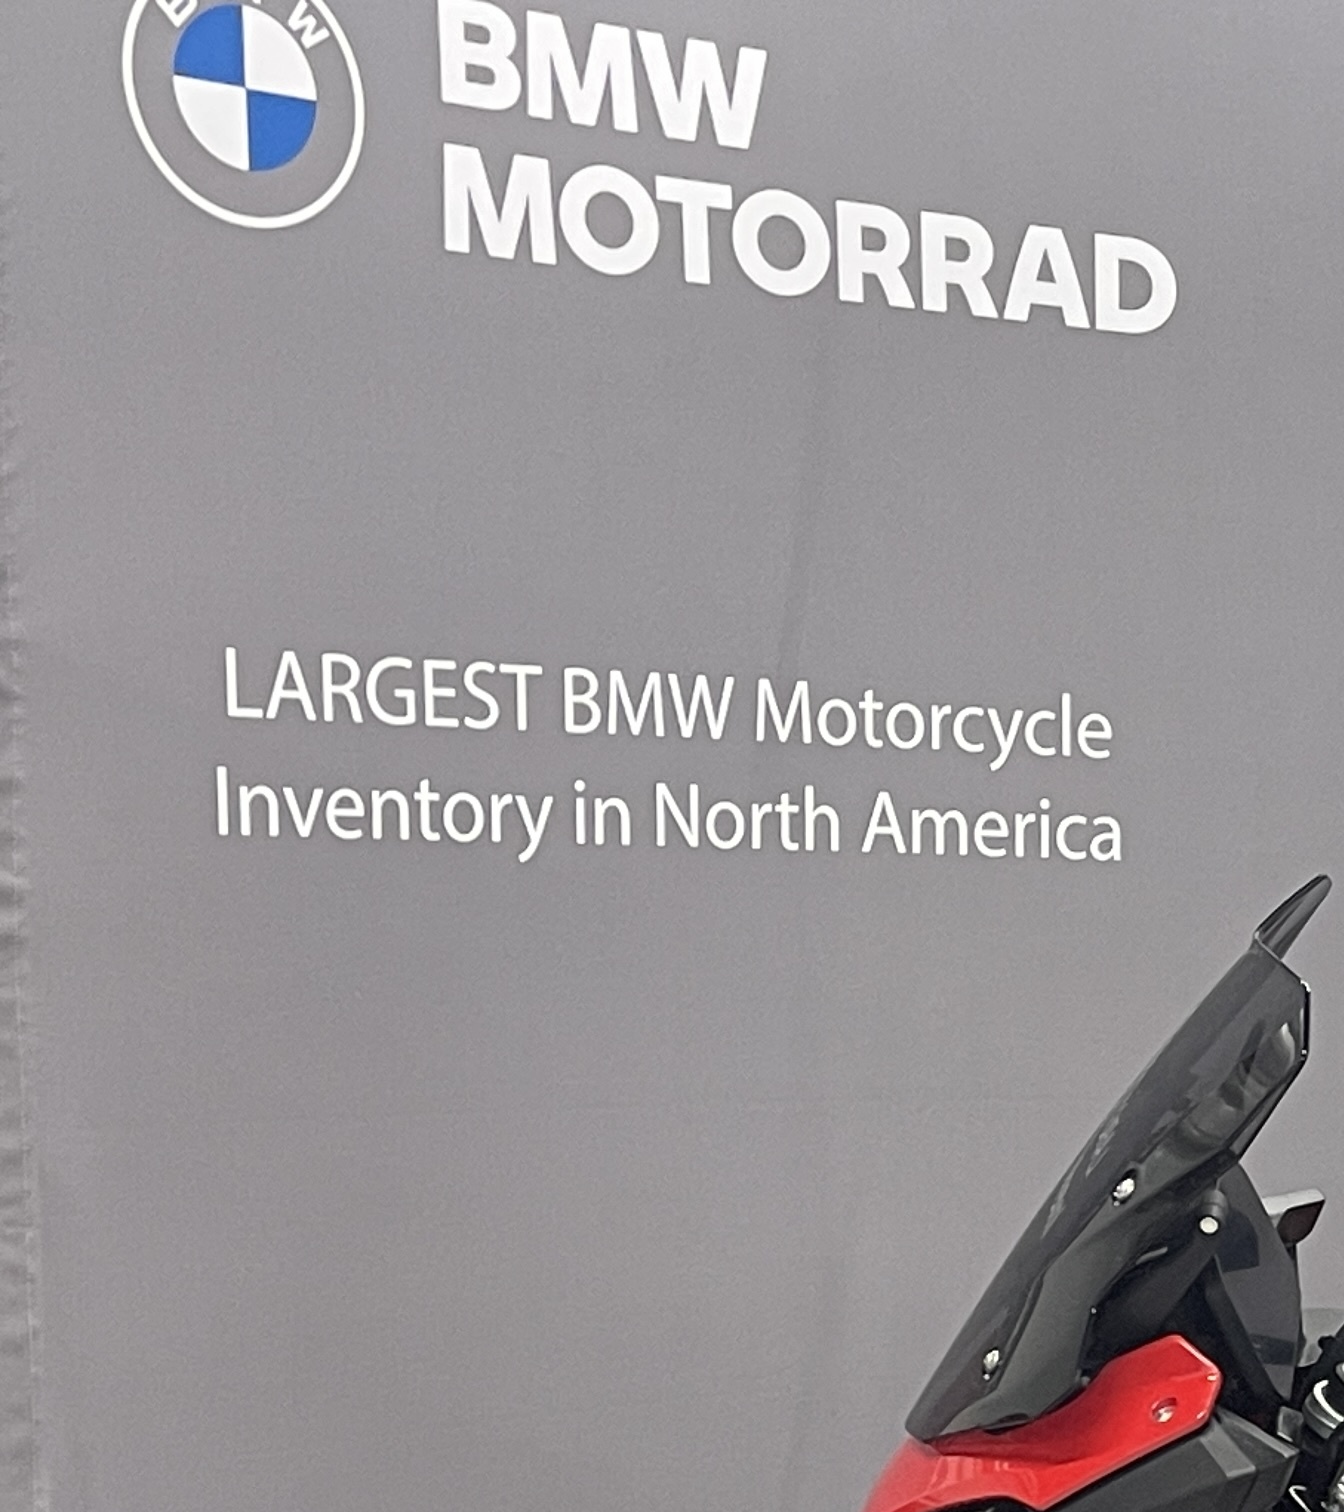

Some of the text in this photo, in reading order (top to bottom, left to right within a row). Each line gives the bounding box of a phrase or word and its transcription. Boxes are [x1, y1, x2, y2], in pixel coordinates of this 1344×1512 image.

[437, 0, 768, 150] BMW
[443, 142, 1177, 334] MOTORRAD
[224, 645, 1114, 773] LARGEST BMW Motorcycle
[215, 764, 1123, 864] Inventory in North America
